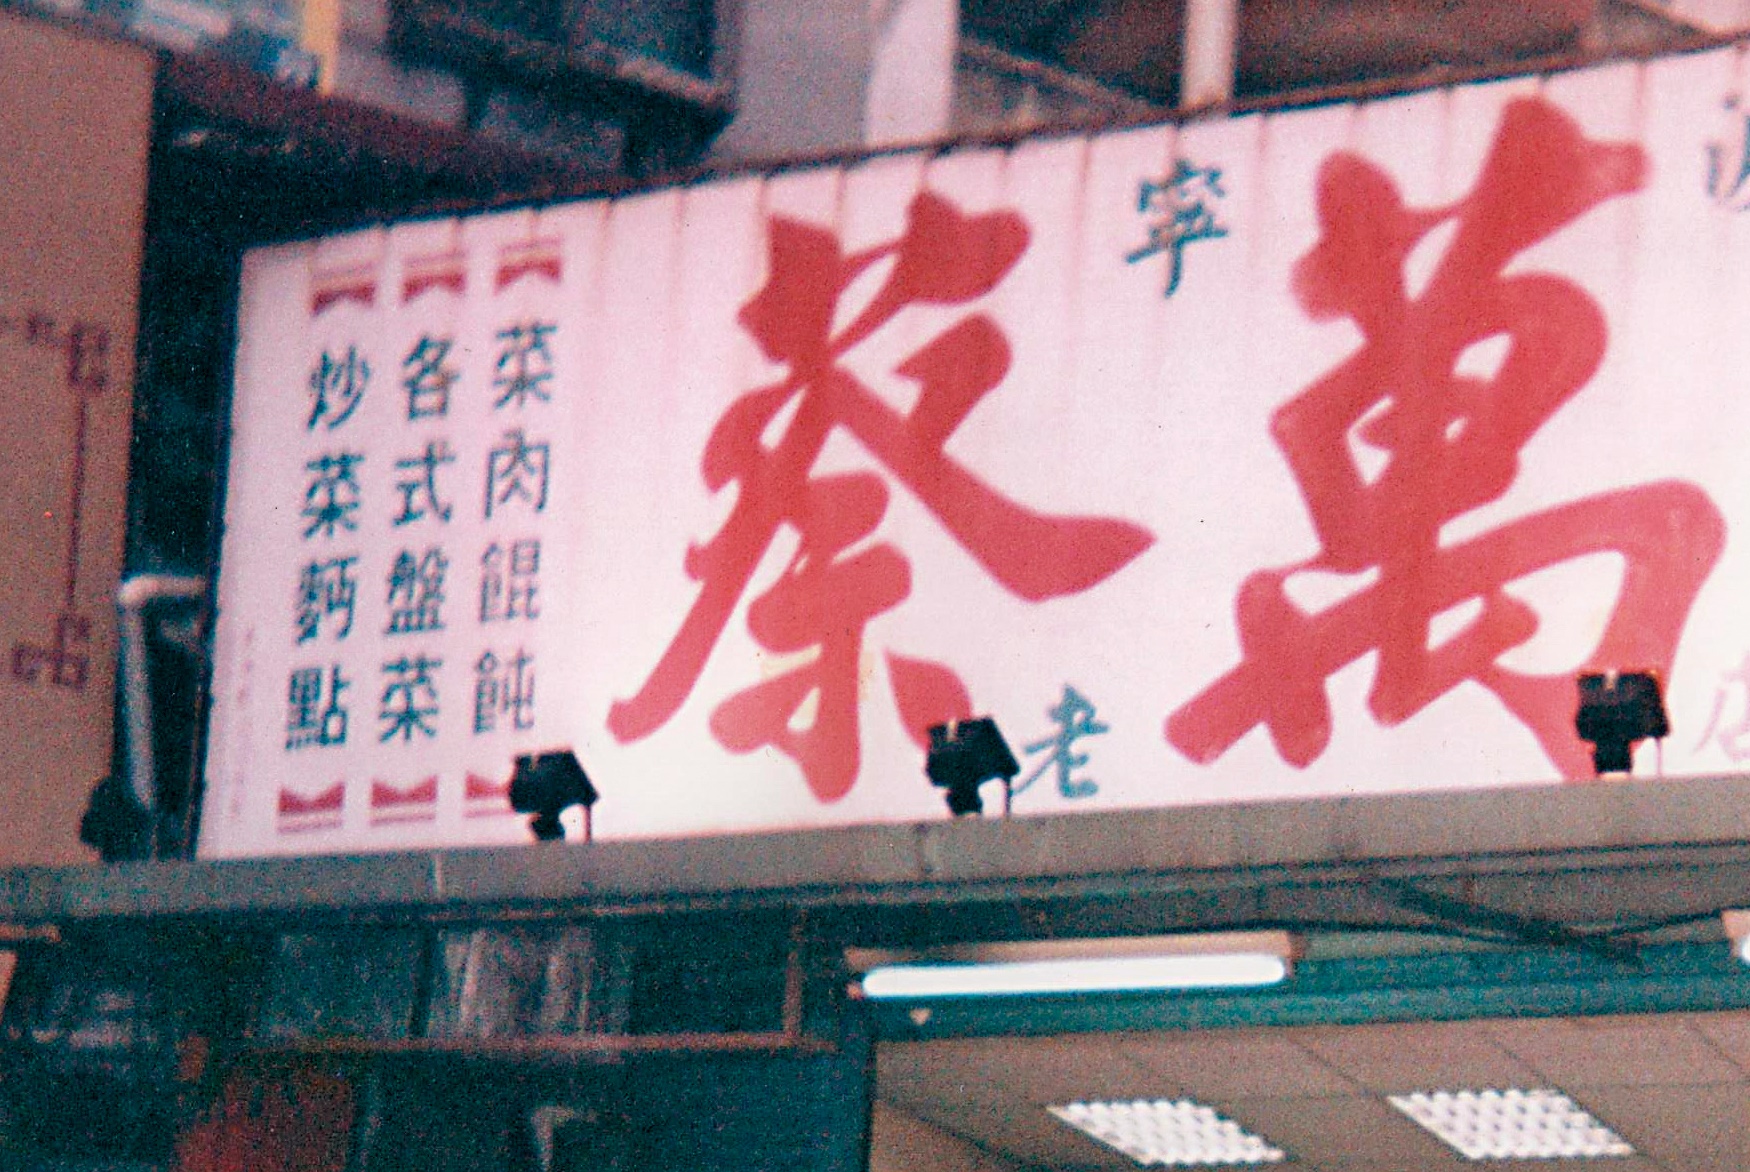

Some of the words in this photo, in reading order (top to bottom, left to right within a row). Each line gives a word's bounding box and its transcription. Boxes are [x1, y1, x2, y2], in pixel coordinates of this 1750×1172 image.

[377, 334, 460, 743] 各式盤菜
[472, 318, 558, 735] 菜肉餛飩
